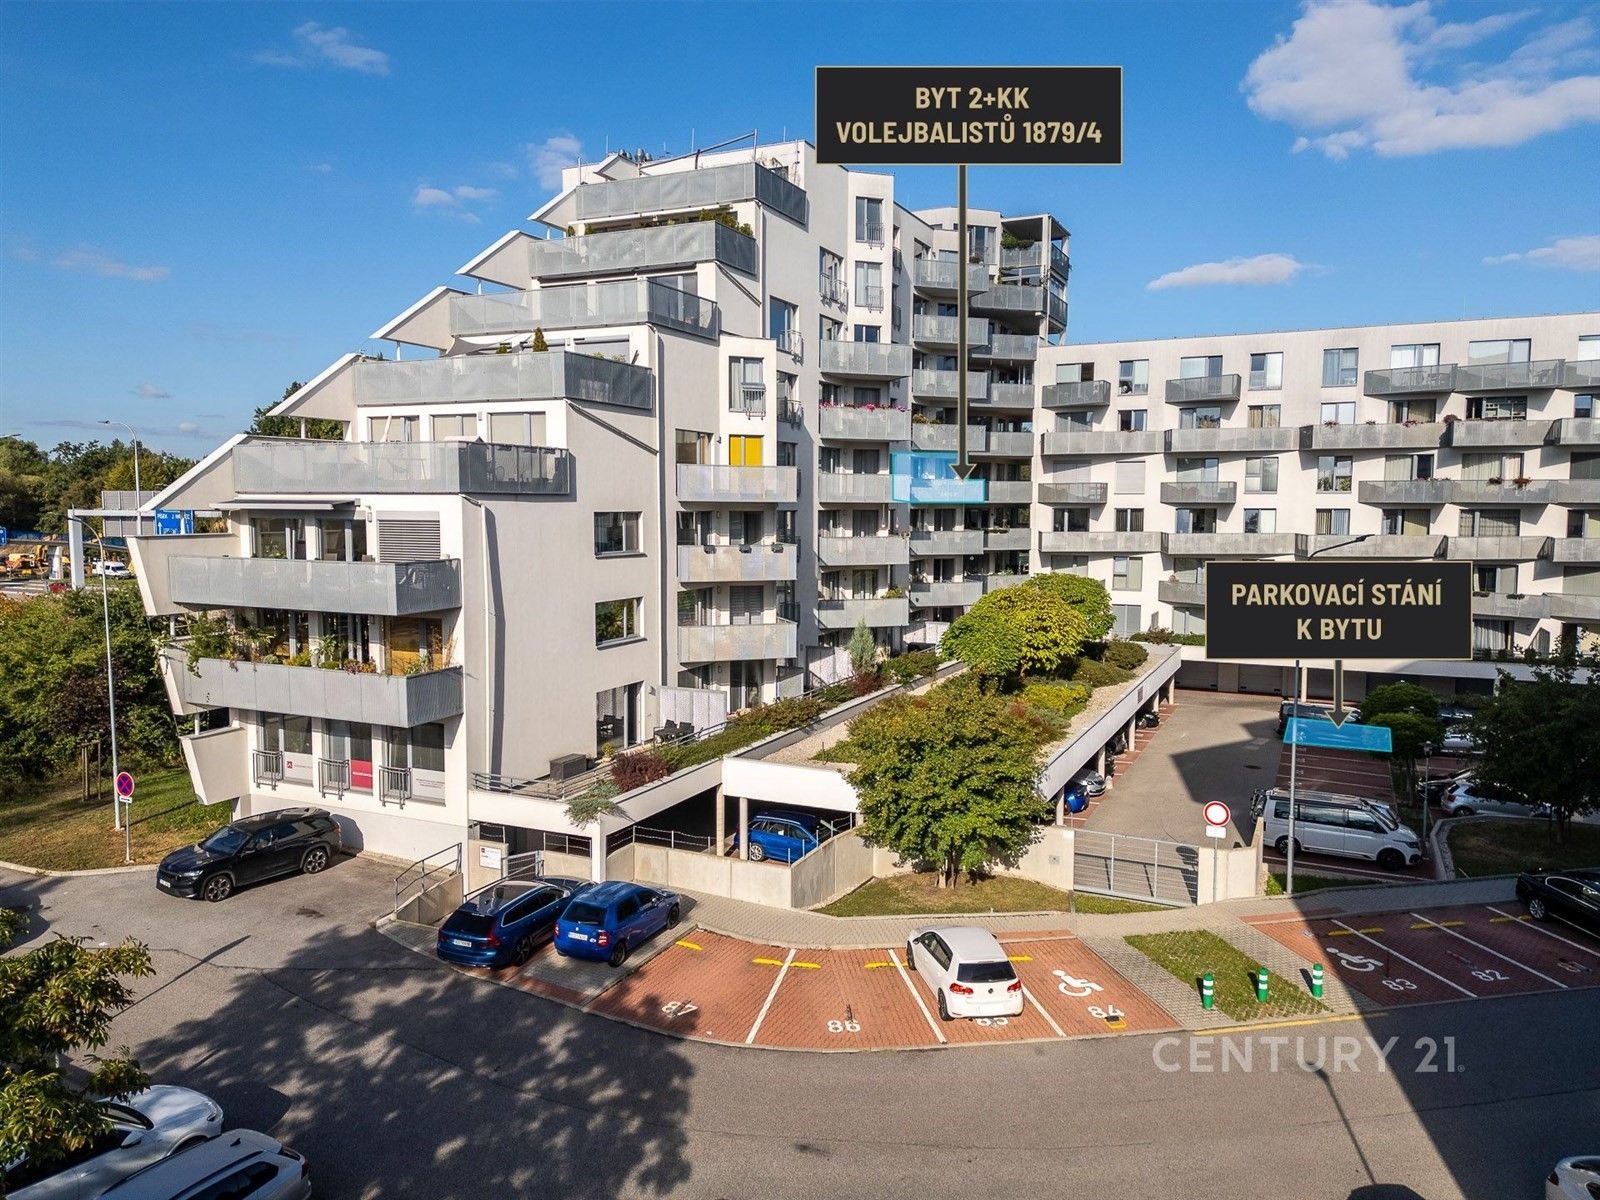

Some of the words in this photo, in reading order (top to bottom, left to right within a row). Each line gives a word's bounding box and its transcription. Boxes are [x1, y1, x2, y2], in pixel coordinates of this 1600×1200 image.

[1471, 969, 1510, 982] 82
[1382, 978, 1418, 991] 83
[1087, 1004, 1125, 1019] 84
[826, 1019, 861, 1033] 86
